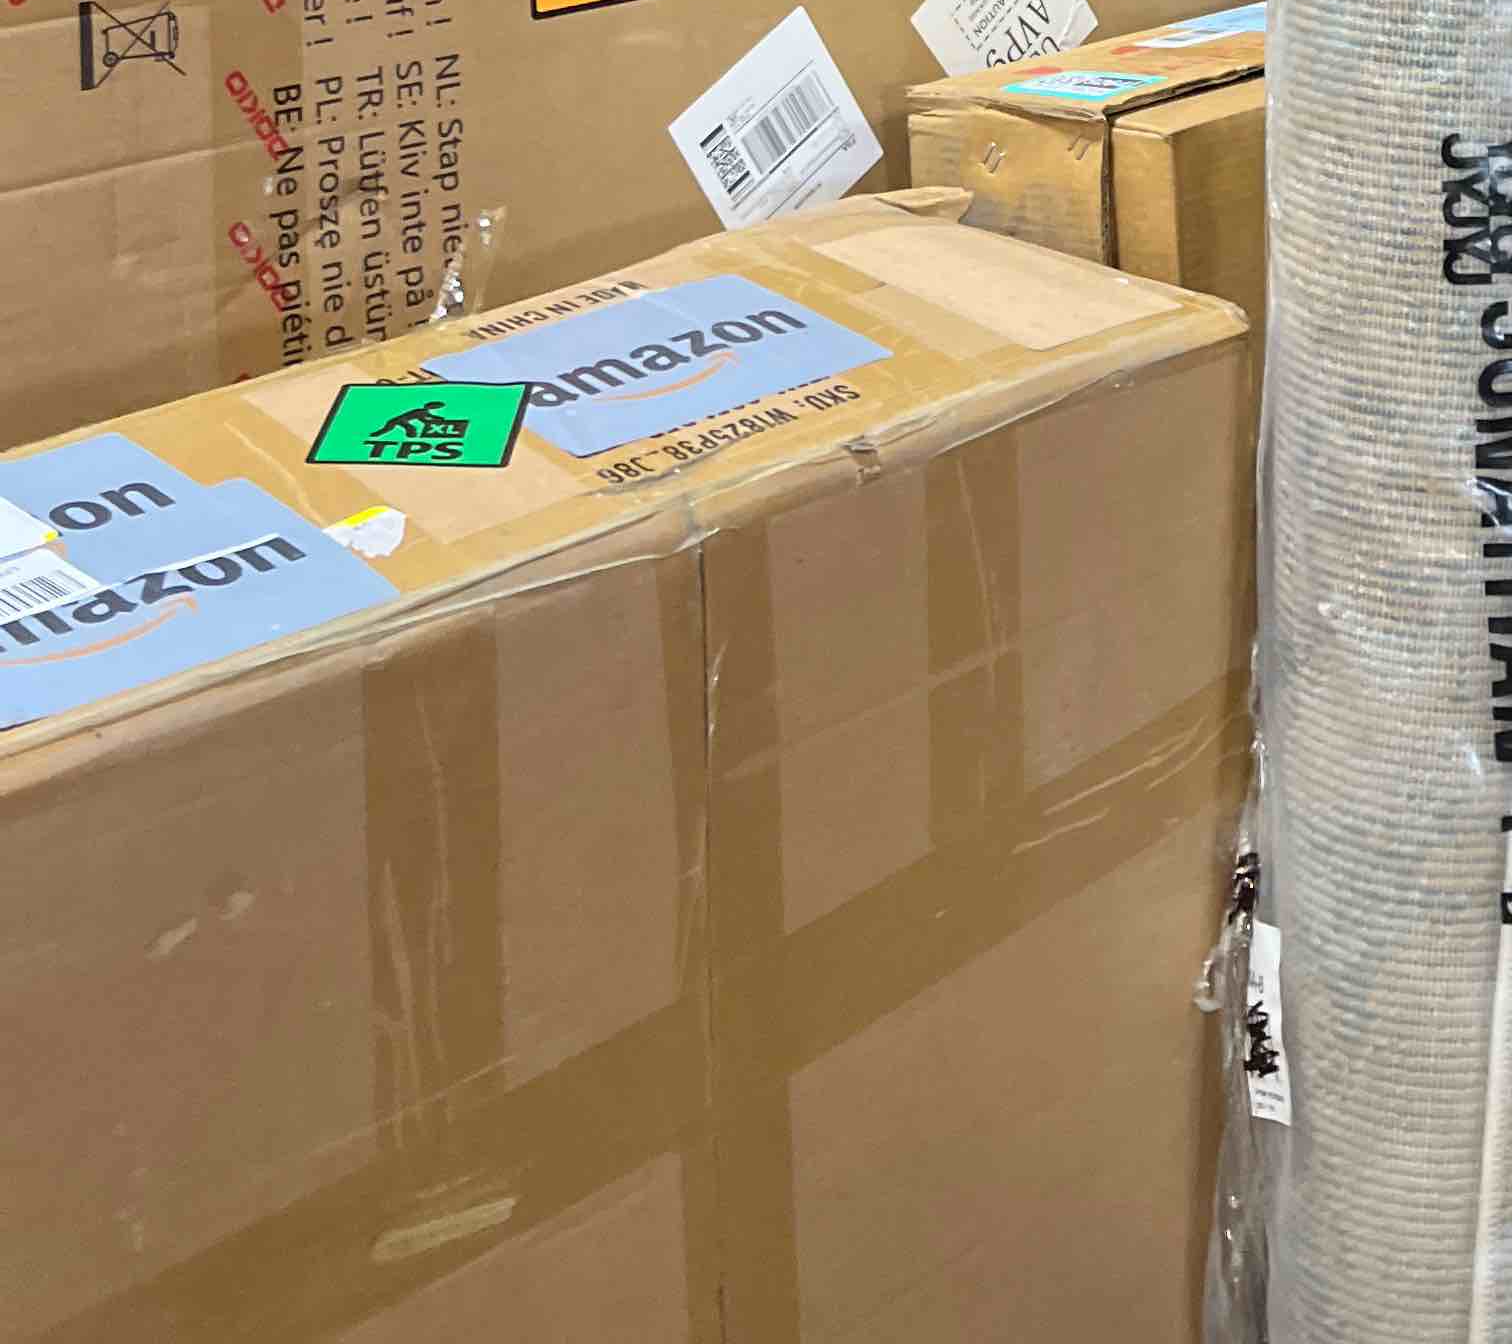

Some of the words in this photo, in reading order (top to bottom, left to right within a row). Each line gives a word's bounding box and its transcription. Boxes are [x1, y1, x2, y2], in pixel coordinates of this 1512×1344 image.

[315, 77, 342, 124] PL:
[355, 66, 383, 120] TR:
[396, 61, 423, 108] SE:
[434, 54, 461, 108] NL:
[272, 84, 302, 132] BE:
[276, 147, 305, 196] Ne
[398, 120, 427, 178] Kliv
[432, 118, 463, 190] Stap
[312, 136, 345, 248] Proszę
[357, 131, 389, 239] Lütfen
[270, 209, 306, 267] pas
[401, 192, 429, 254] inte
[320, 262, 352, 312] nie
[397, 266, 433, 307] på
[464, 310, 547, 341] CHINA
[529, 307, 808, 408] amazon
[796, 385, 861, 411] SKU:
[362, 441, 465, 461] TPS
[429, 424, 460, 436] XL
